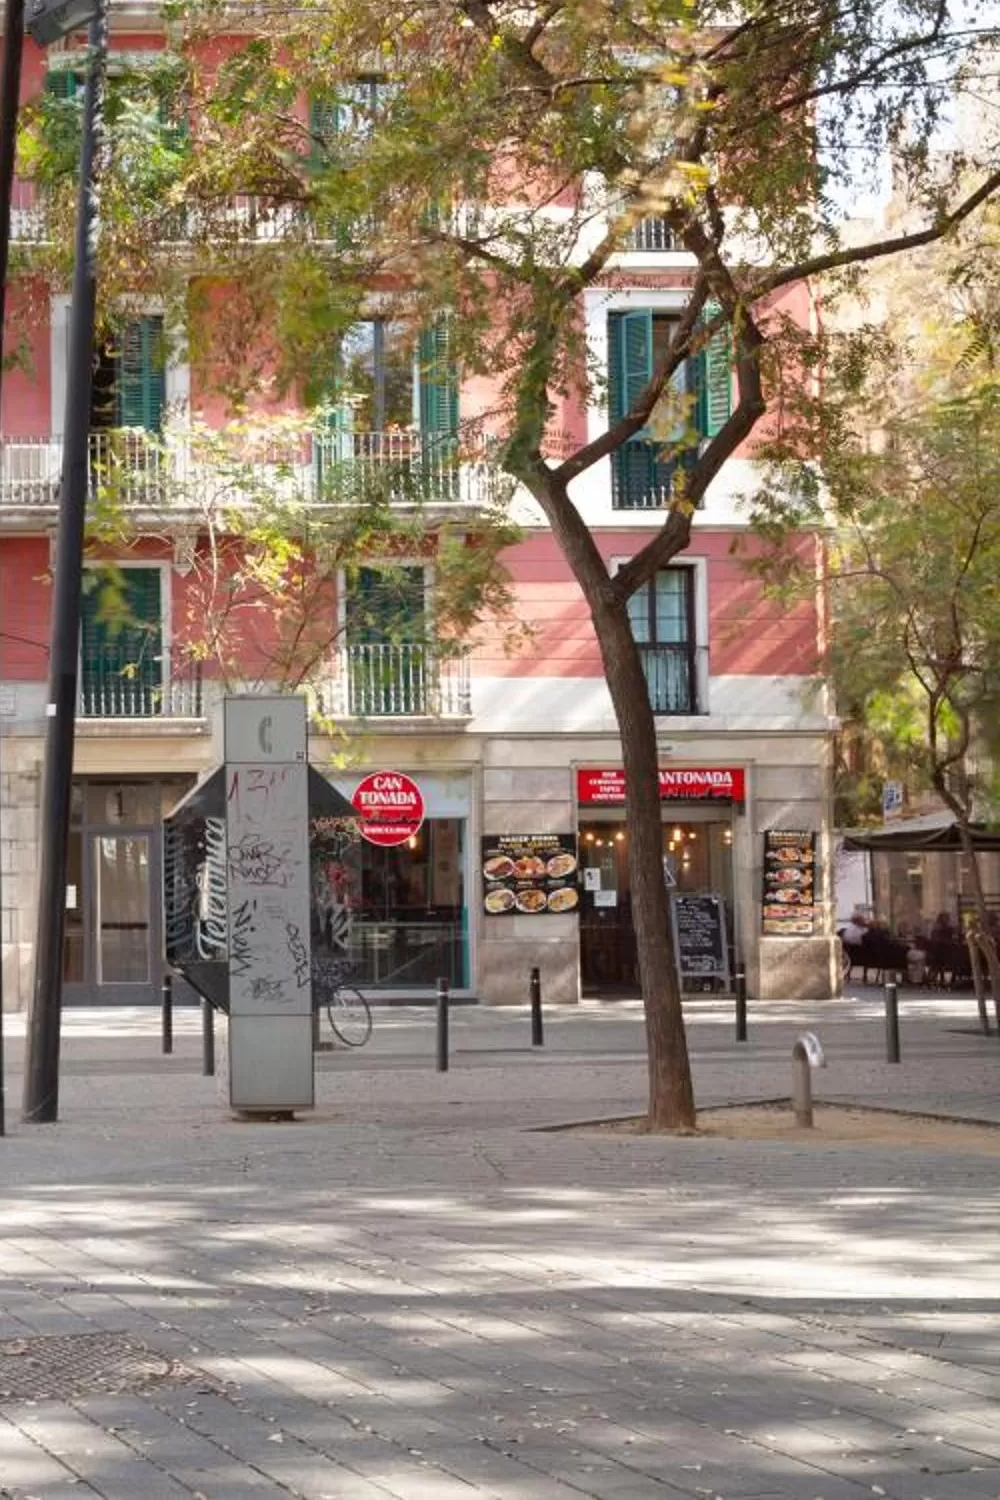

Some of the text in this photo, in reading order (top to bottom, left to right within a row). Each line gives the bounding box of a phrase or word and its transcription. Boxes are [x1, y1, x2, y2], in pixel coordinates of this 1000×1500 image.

[373, 777, 403, 791] CAN
[658, 771, 732, 785] ANTONADA
[360, 791, 417, 805] TONADA
